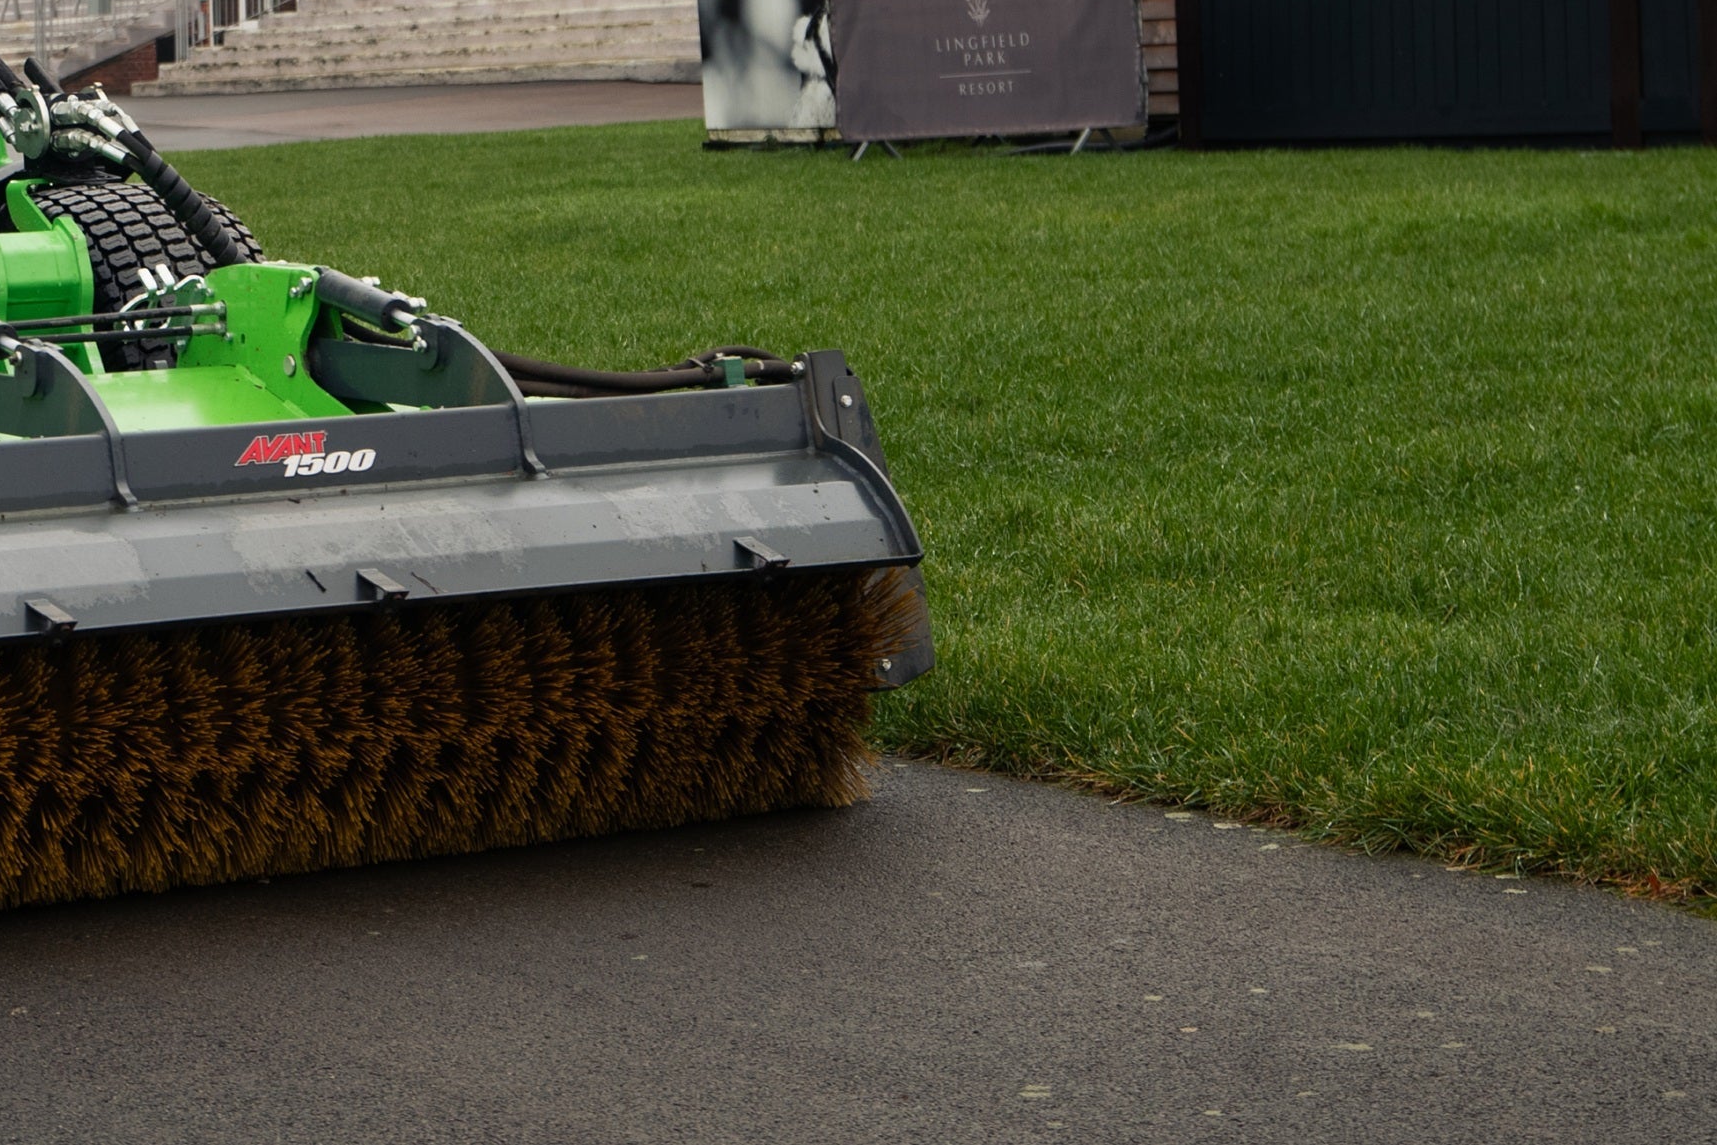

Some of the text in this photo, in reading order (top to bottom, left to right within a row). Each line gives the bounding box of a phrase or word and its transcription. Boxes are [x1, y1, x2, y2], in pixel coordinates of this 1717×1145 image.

[935, 32, 1030, 53] LINGFIELD
[964, 51, 1006, 67] PARK
[959, 80, 1014, 96] RESORT
[234, 430, 328, 467] AVANT
[283, 448, 377, 478] 1500
